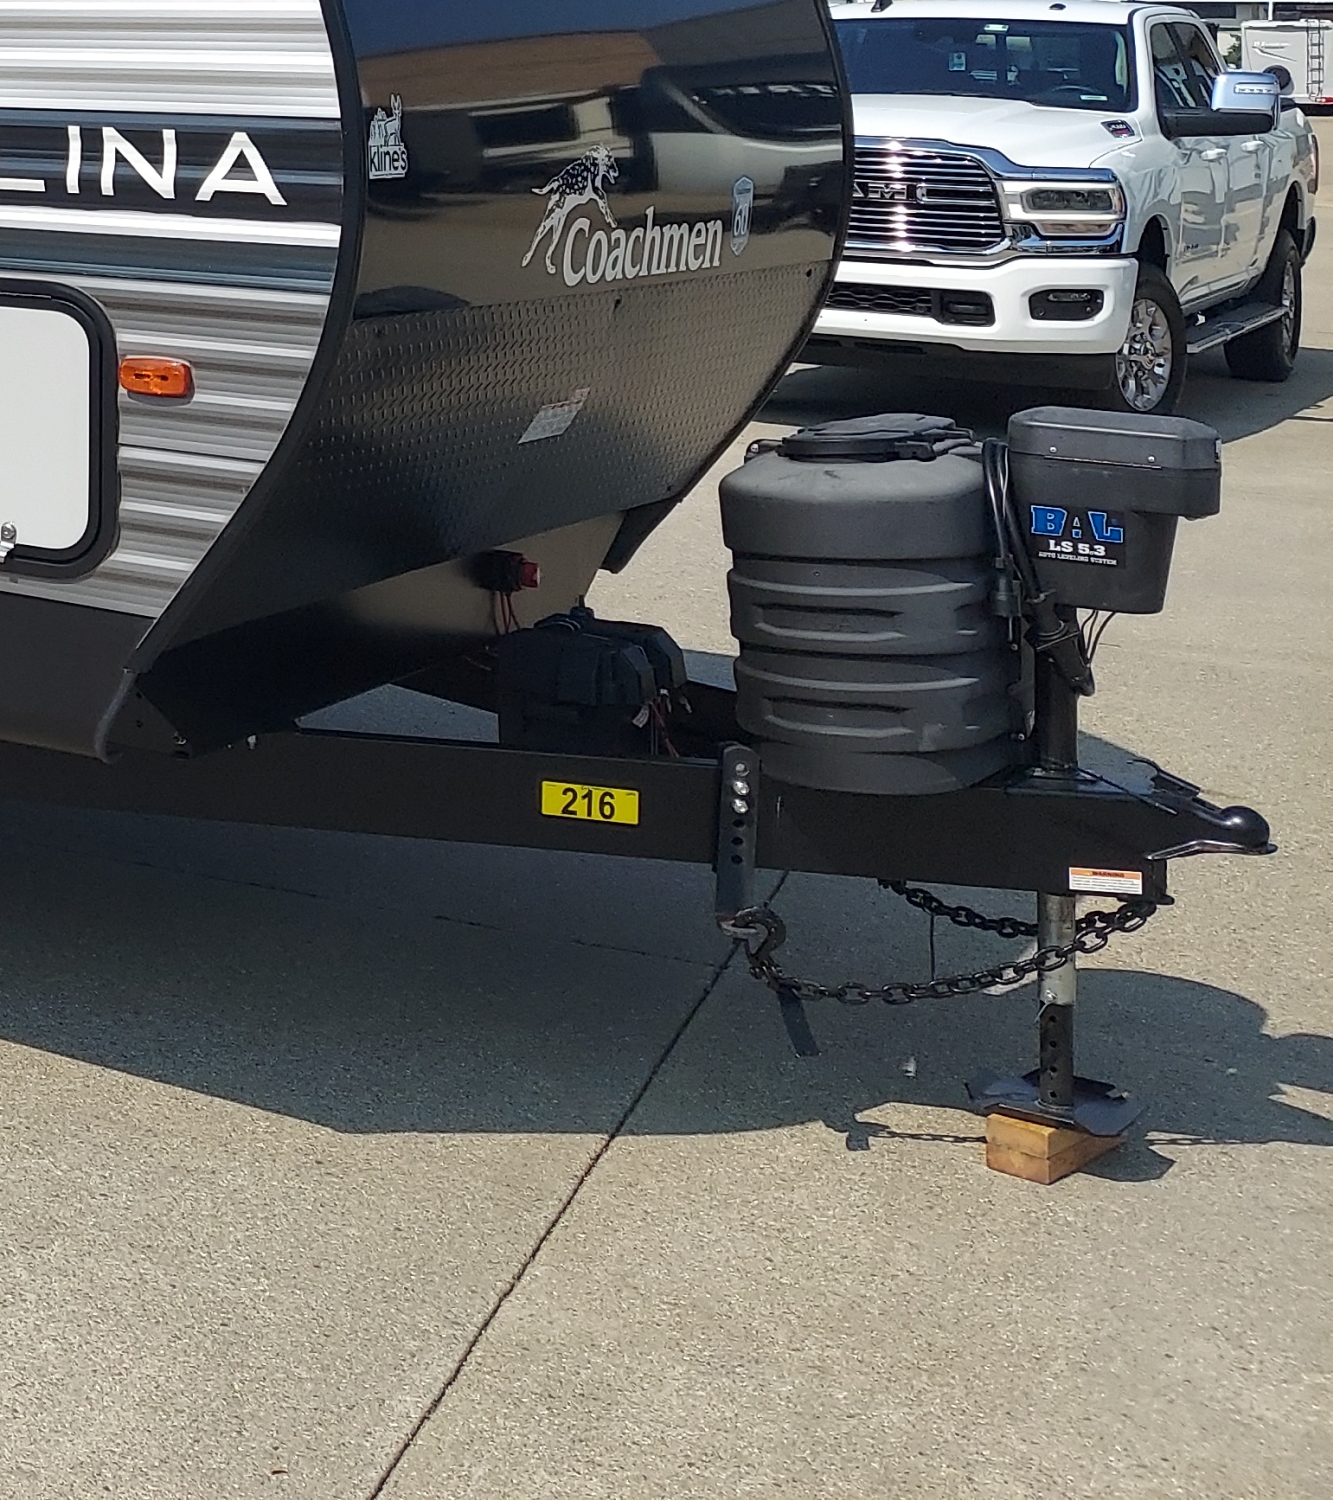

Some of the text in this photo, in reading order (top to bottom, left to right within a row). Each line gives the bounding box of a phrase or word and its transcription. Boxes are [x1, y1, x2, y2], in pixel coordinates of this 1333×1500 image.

[369, 145, 408, 173] kline's
[563, 205, 723, 287] Coachmen
[1030, 505, 1123, 543] BAL
[1048, 539, 1106, 556] LS 5.3
[560, 787, 615, 820] 216
